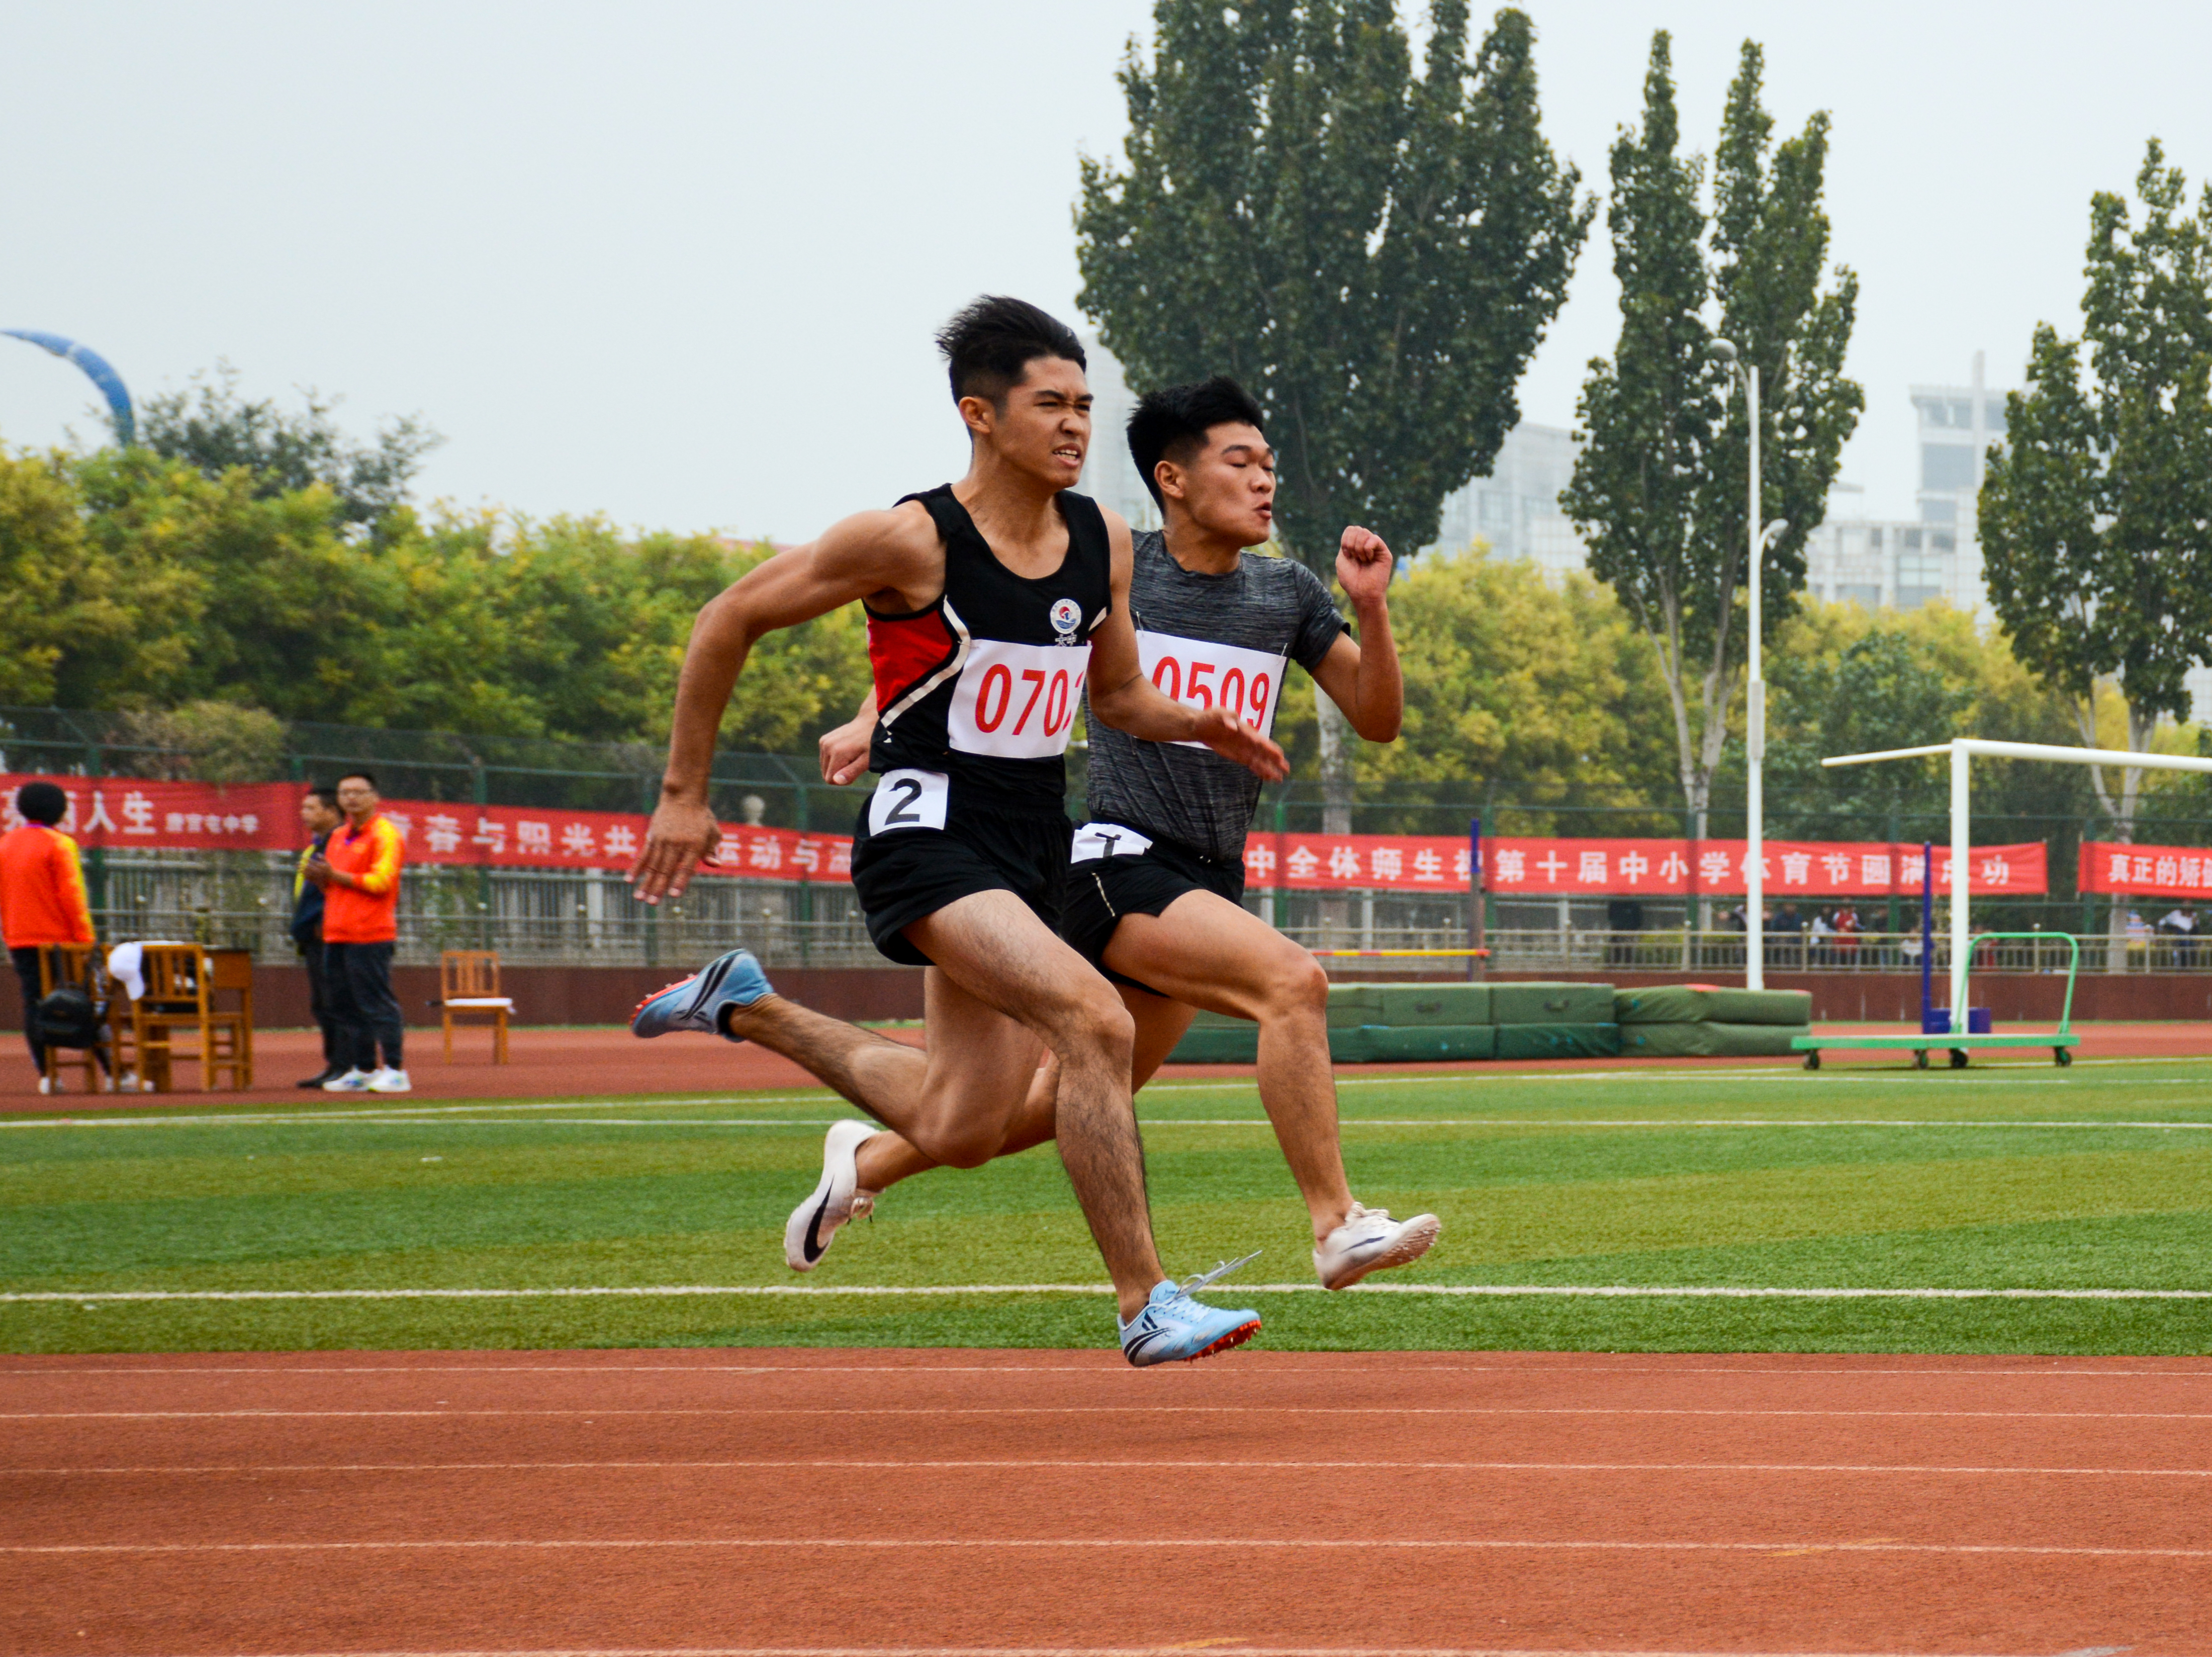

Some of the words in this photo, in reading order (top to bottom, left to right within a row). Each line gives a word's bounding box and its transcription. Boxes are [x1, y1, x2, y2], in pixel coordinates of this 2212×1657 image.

[975, 664, 1084, 737] 070
[1152, 656, 1269, 732] 0509
[884, 778, 922, 826] 2
